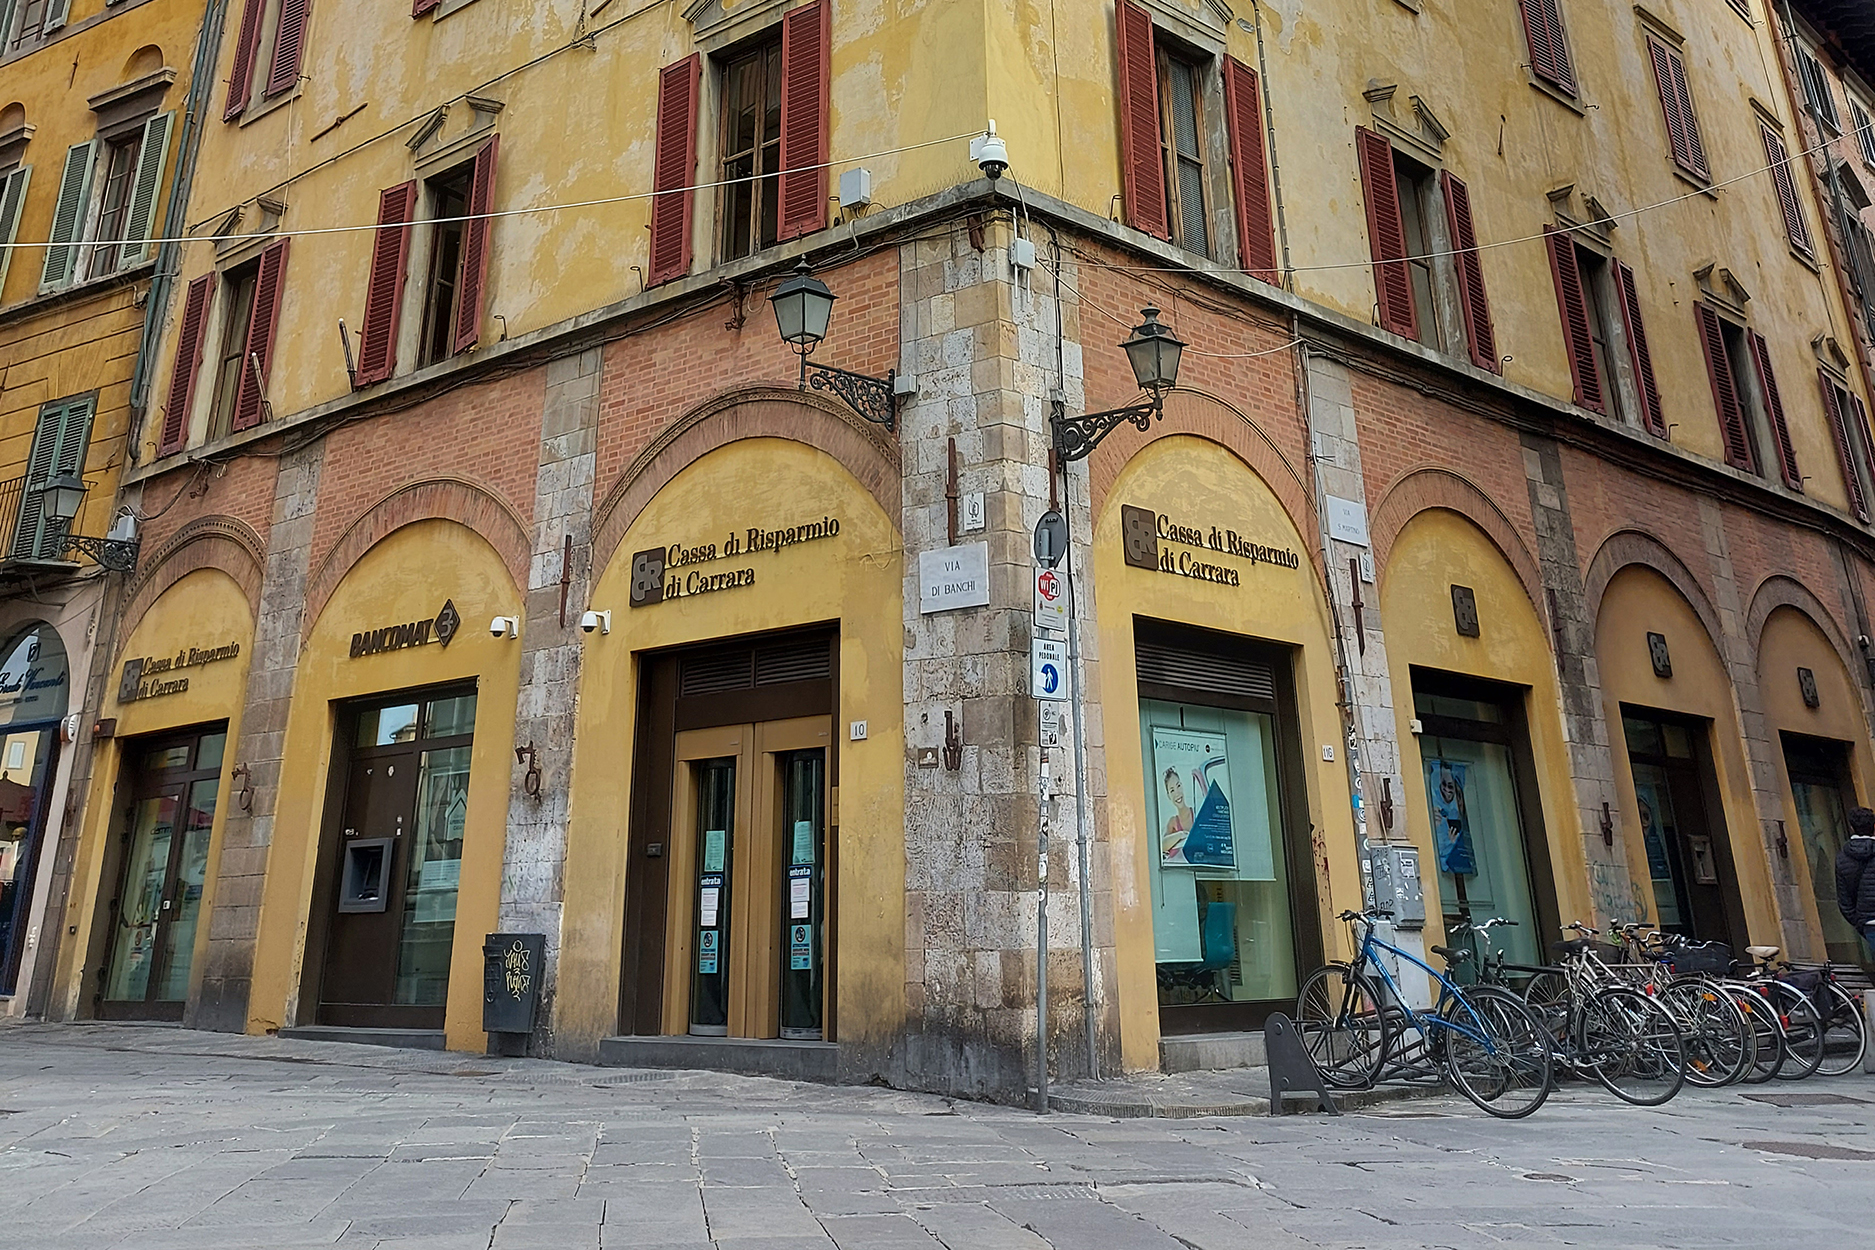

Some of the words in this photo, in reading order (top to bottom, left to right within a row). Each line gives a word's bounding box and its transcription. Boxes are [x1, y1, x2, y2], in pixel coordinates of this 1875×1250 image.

[667, 543, 717, 568] Cassa
[723, 531, 741, 557] di
[746, 516, 840, 553] Risparmio
[1157, 514, 1203, 547] Cassa
[1209, 526, 1222, 550] di
[1226, 530, 1299, 570] Risparmio
[944, 561, 961, 571] VIA
[1160, 548, 1175, 573] di
[1180, 551, 1240, 587] Carrara
[665, 575, 681, 599] di
[686, 567, 755, 596] Carrara
[931, 586, 940, 596] DI
[944, 581, 976, 595] BANCHI
[350, 618, 434, 658] BANCOMAT
[1043, 643, 1055, 652] AREA
[142, 656, 172, 675] Cassa
[176, 650, 187, 668] di
[188, 641, 240, 670] Risparmio
[1038, 652, 1060, 661] PEDONALE
[137, 681, 149, 699] di
[151, 678, 189, 696] Carrara
[854, 723, 865, 737] 10
